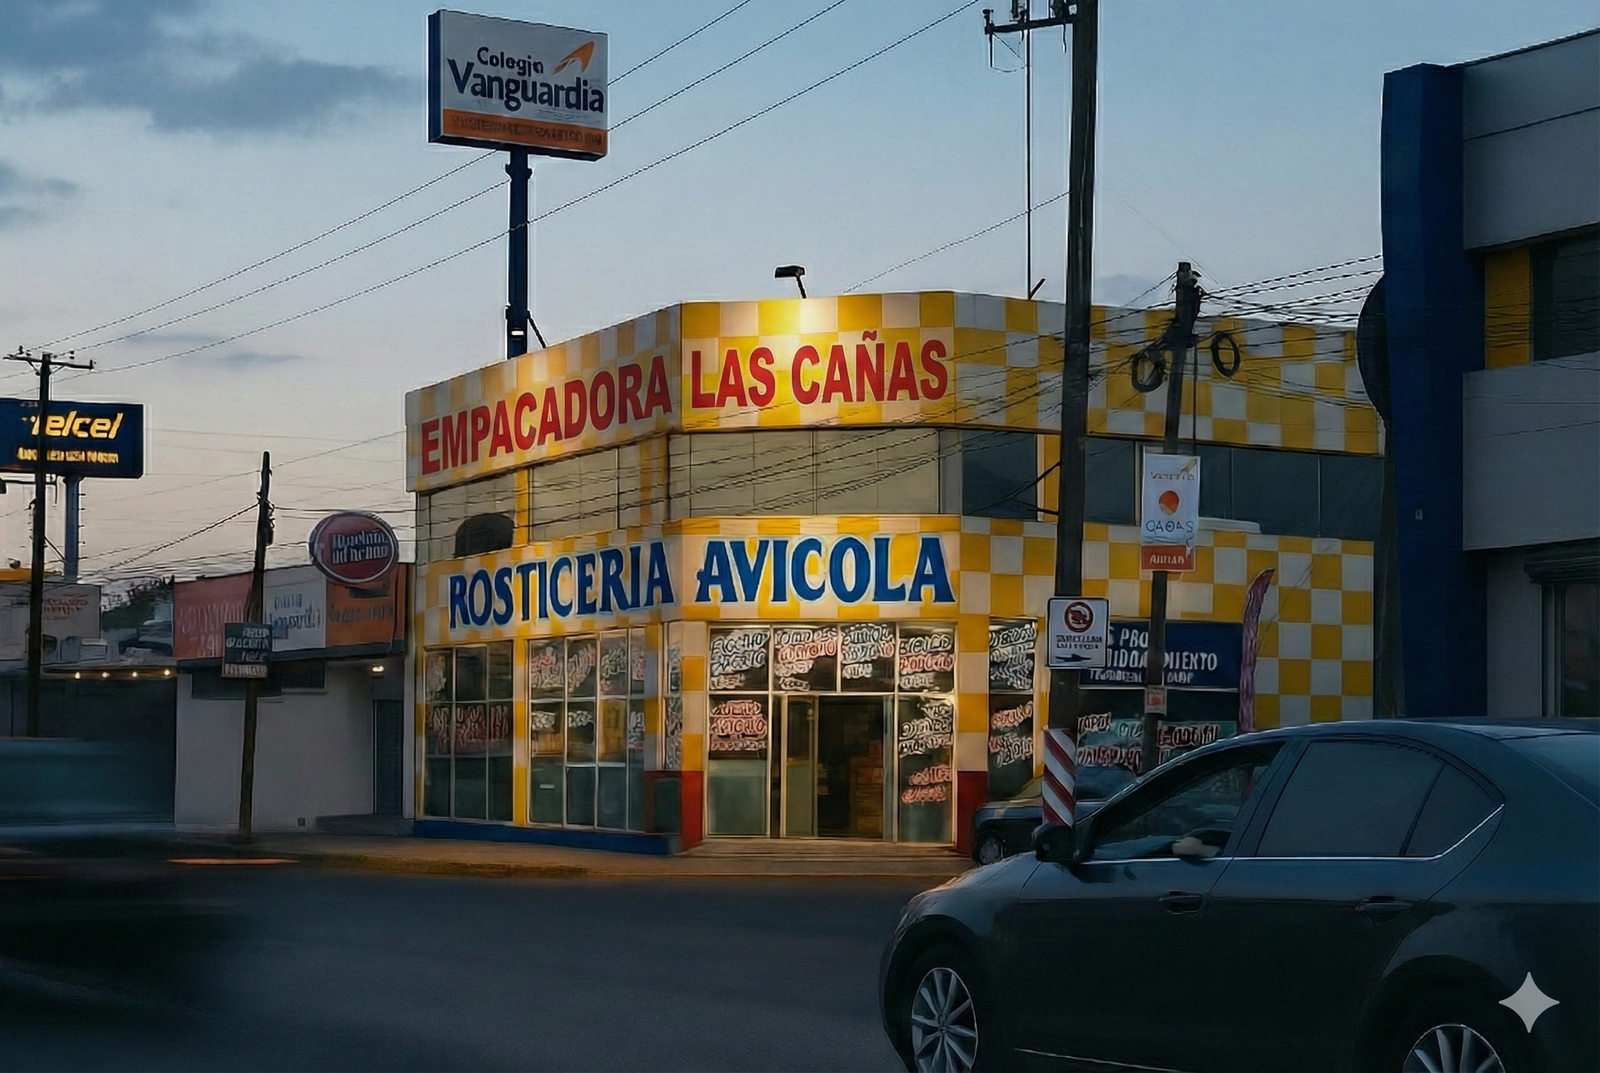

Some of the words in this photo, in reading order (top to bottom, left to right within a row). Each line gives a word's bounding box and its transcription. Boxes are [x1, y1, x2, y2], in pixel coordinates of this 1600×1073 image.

[447, 58, 604, 113] Vanguardia
[691, 346, 777, 410] LAS
[791, 330, 949, 405] CAÑAS
[421, 354, 672, 476] EMPACADORA
[449, 541, 676, 629] ROSTICERIA
[695, 536, 956, 603] AVICOLA
